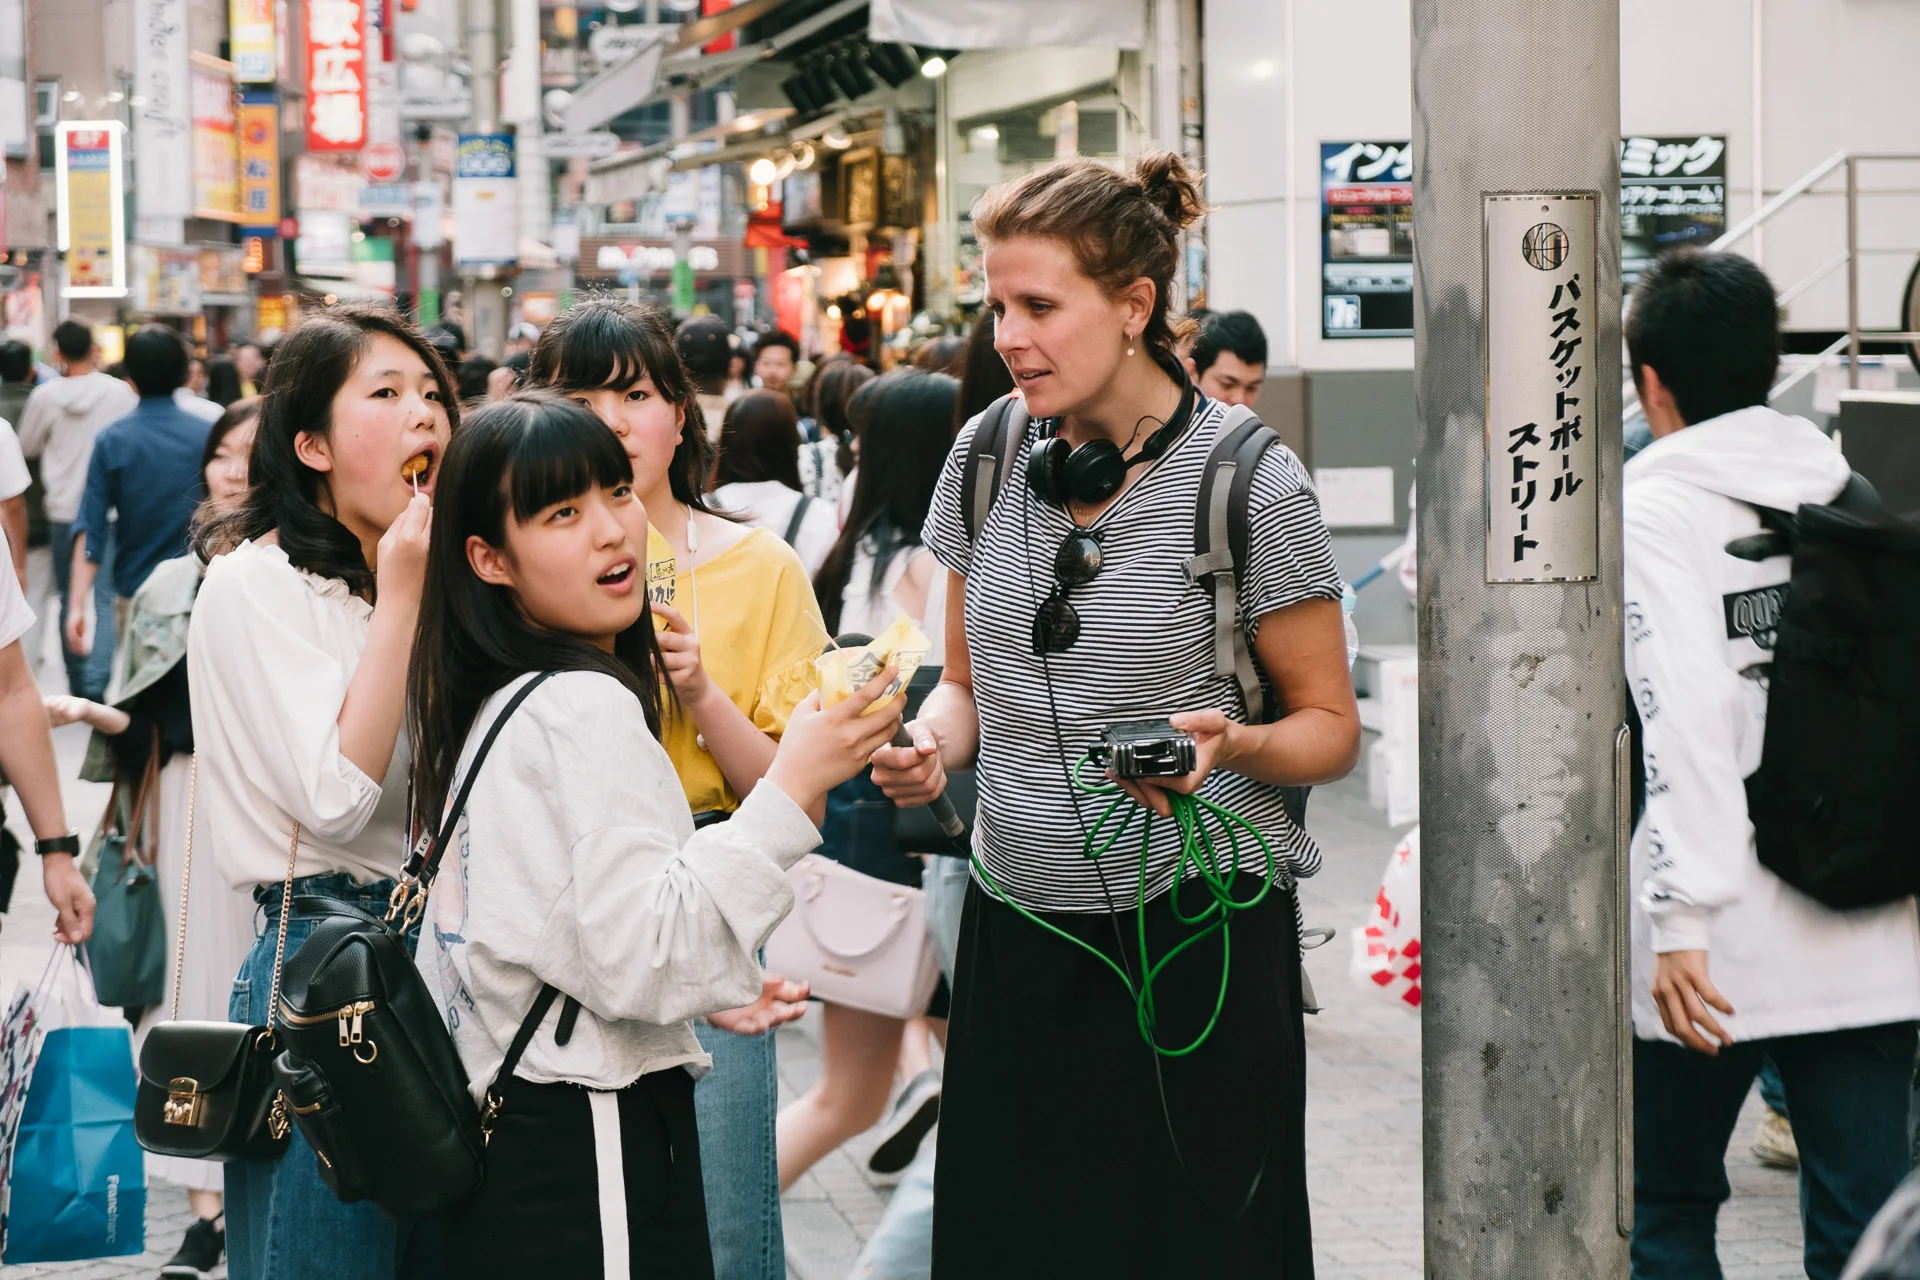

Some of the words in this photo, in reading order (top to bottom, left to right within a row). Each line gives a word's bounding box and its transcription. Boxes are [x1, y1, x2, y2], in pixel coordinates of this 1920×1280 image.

[1619, 136, 1724, 177] ミック
[1548, 272, 1584, 502] バスケットボール
[1507, 422, 1541, 563] ストリート
